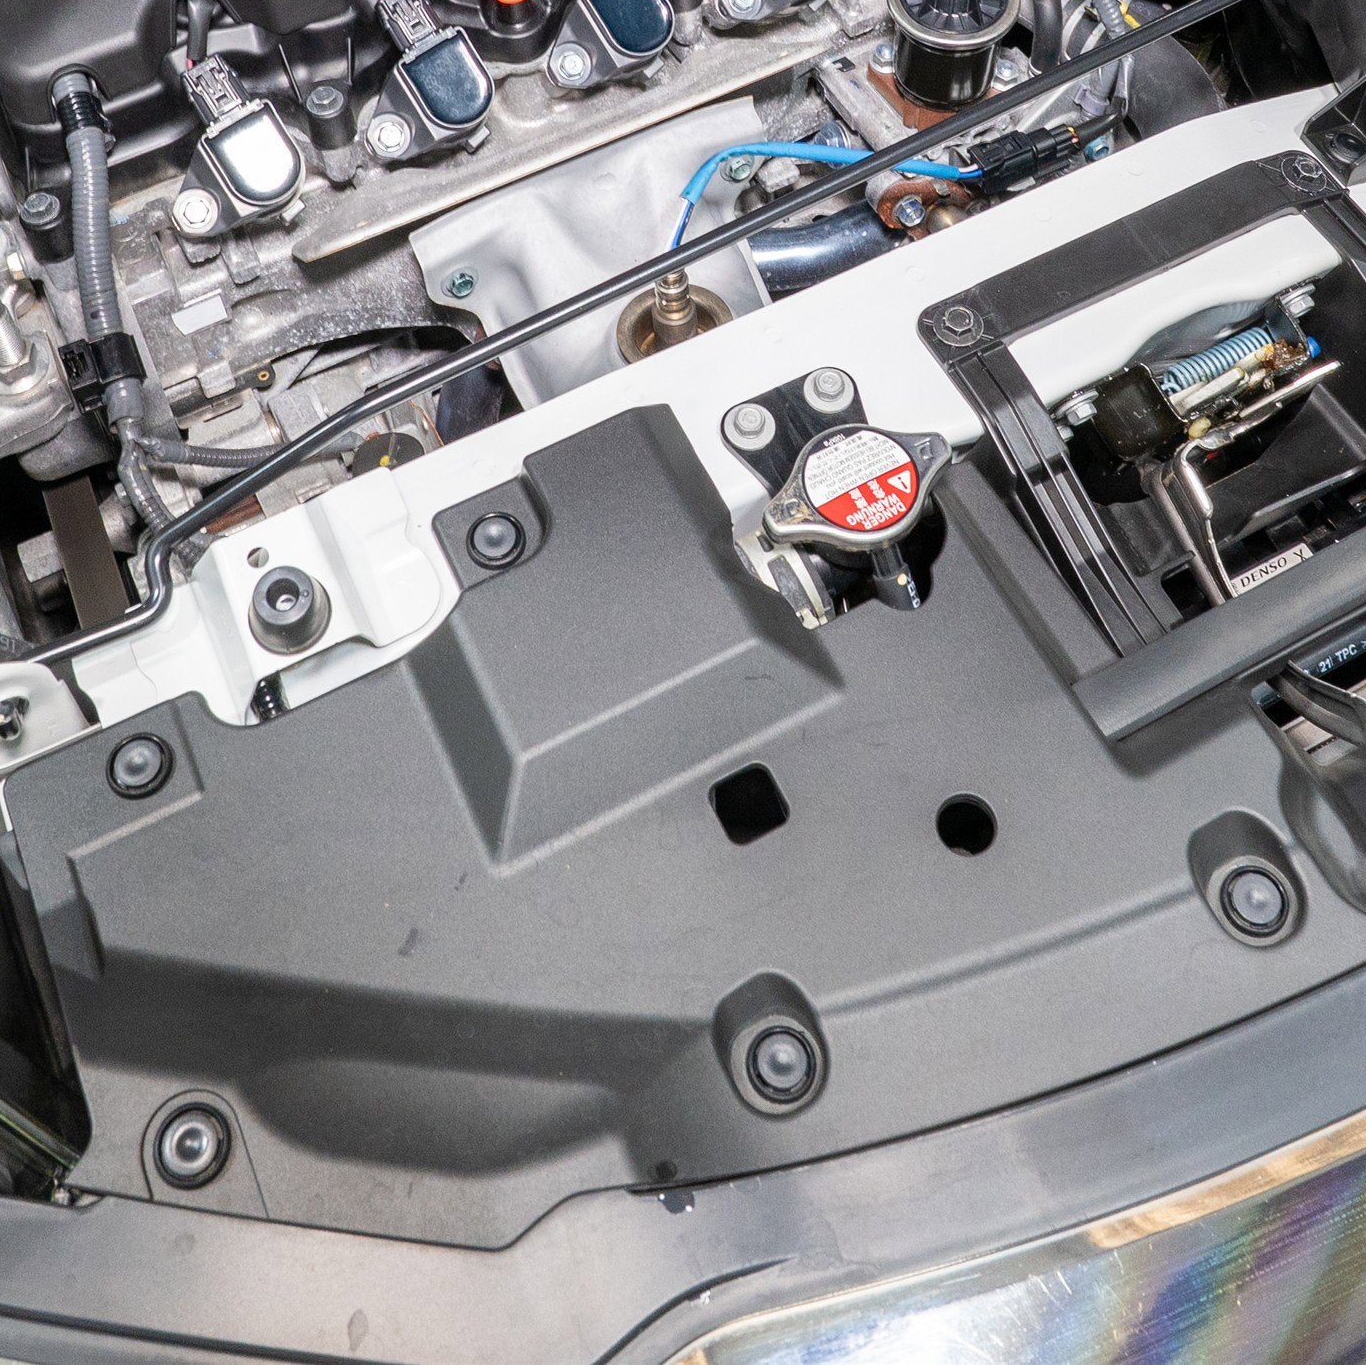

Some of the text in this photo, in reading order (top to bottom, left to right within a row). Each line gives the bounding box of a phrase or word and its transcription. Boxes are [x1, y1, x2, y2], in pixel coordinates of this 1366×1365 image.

[822, 458, 899, 499] NEVER OPEN WHEN HOT
[844, 491, 901, 526] WARNUNG
[861, 500, 906, 530] DANGER
[1239, 555, 1288, 588] DENSO
[1334, 643, 1358, 663] TPC
